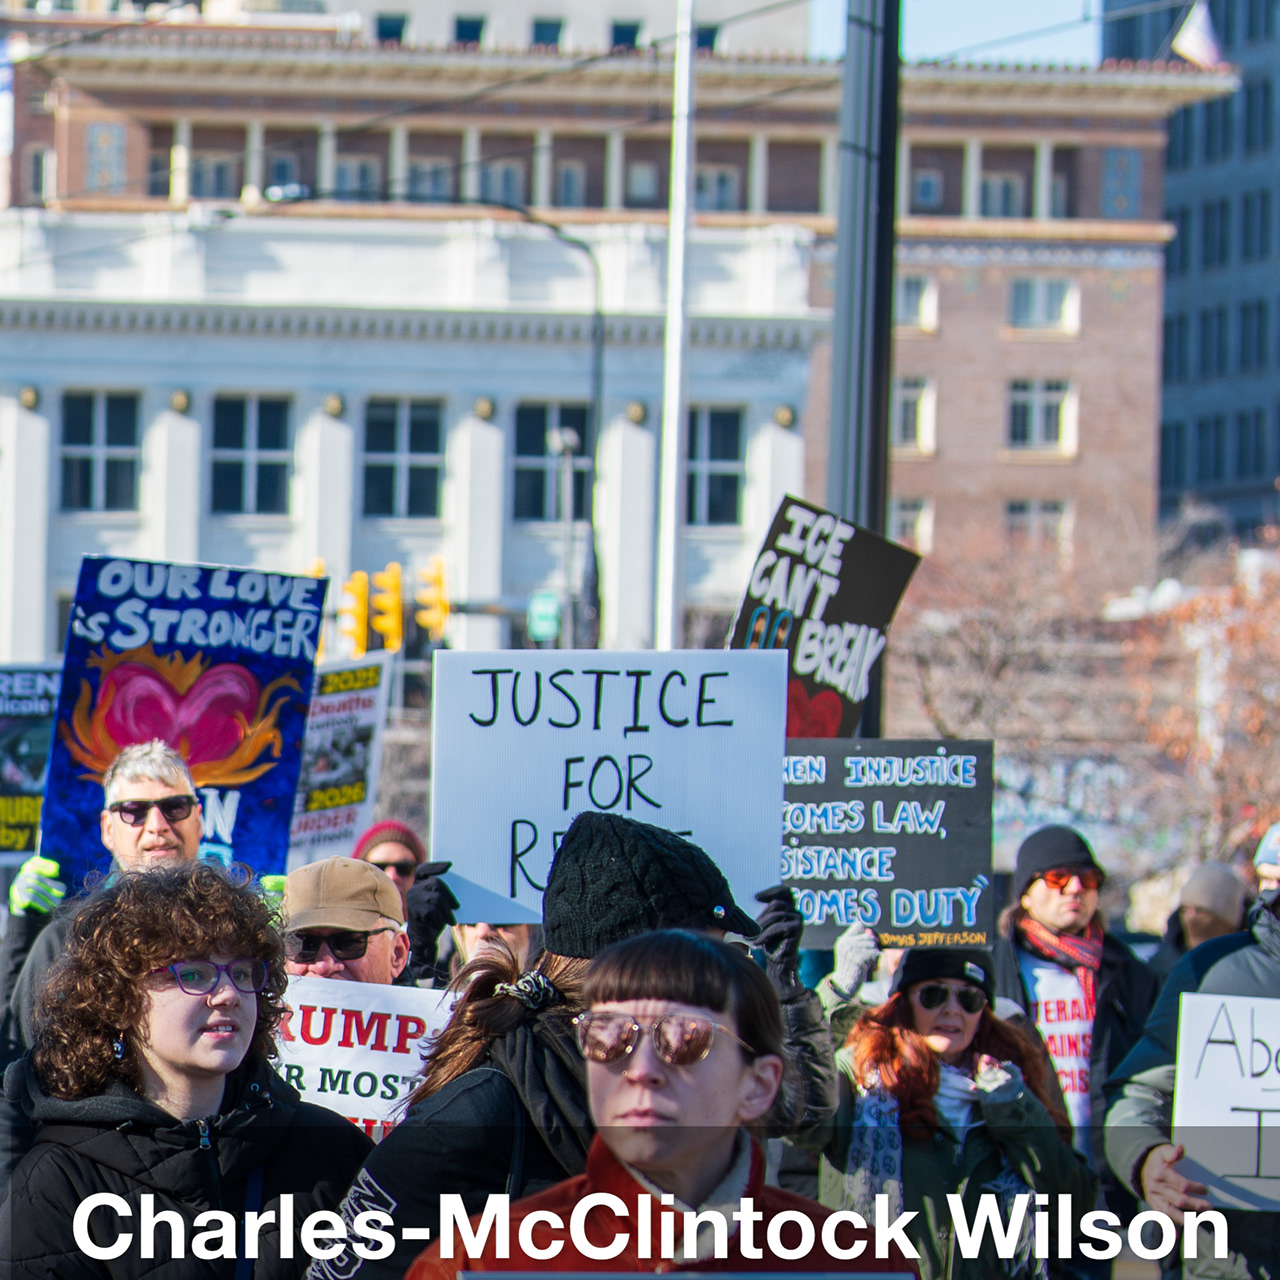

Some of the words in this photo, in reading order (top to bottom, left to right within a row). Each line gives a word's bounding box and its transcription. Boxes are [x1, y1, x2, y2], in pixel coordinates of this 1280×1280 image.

[775, 504, 856, 577] ICE
[97, 560, 203, 600] OUR
[208, 569, 320, 612] LOVE
[749, 550, 841, 622] CAN'T
[109, 598, 318, 663] STRONGER
[792, 619, 887, 704] BREAK
[469, 669, 734, 738] JUSTICE
[563, 754, 663, 811] FOR
[873, 799, 948, 840] LAW,
[791, 887, 882, 927] OMES
